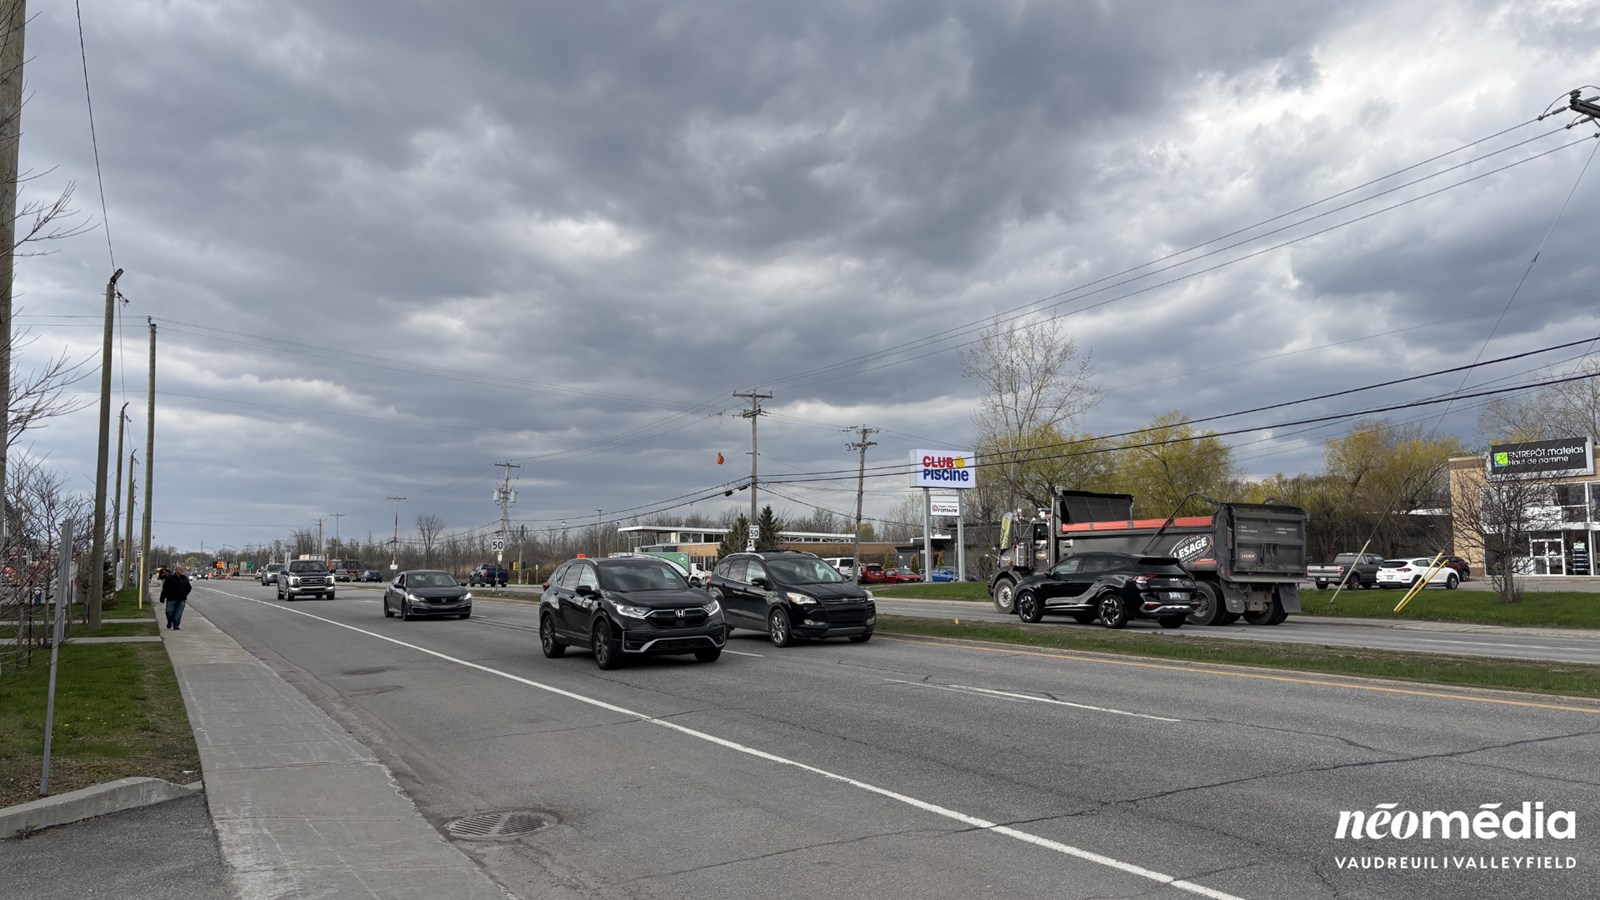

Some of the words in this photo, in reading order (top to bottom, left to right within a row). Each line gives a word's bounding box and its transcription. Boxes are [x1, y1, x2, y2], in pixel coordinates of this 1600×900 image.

[1509, 448, 1546, 458] ENTREPÔT
[1547, 446, 1584, 456] matelas
[922, 456, 954, 468] CLUB
[1509, 458, 1526, 466] Haut
[1527, 457, 1538, 465] de
[750, 529, 759, 537] 50
[492, 541, 503, 550] 50
[1173, 537, 1208, 560] LESAGE
